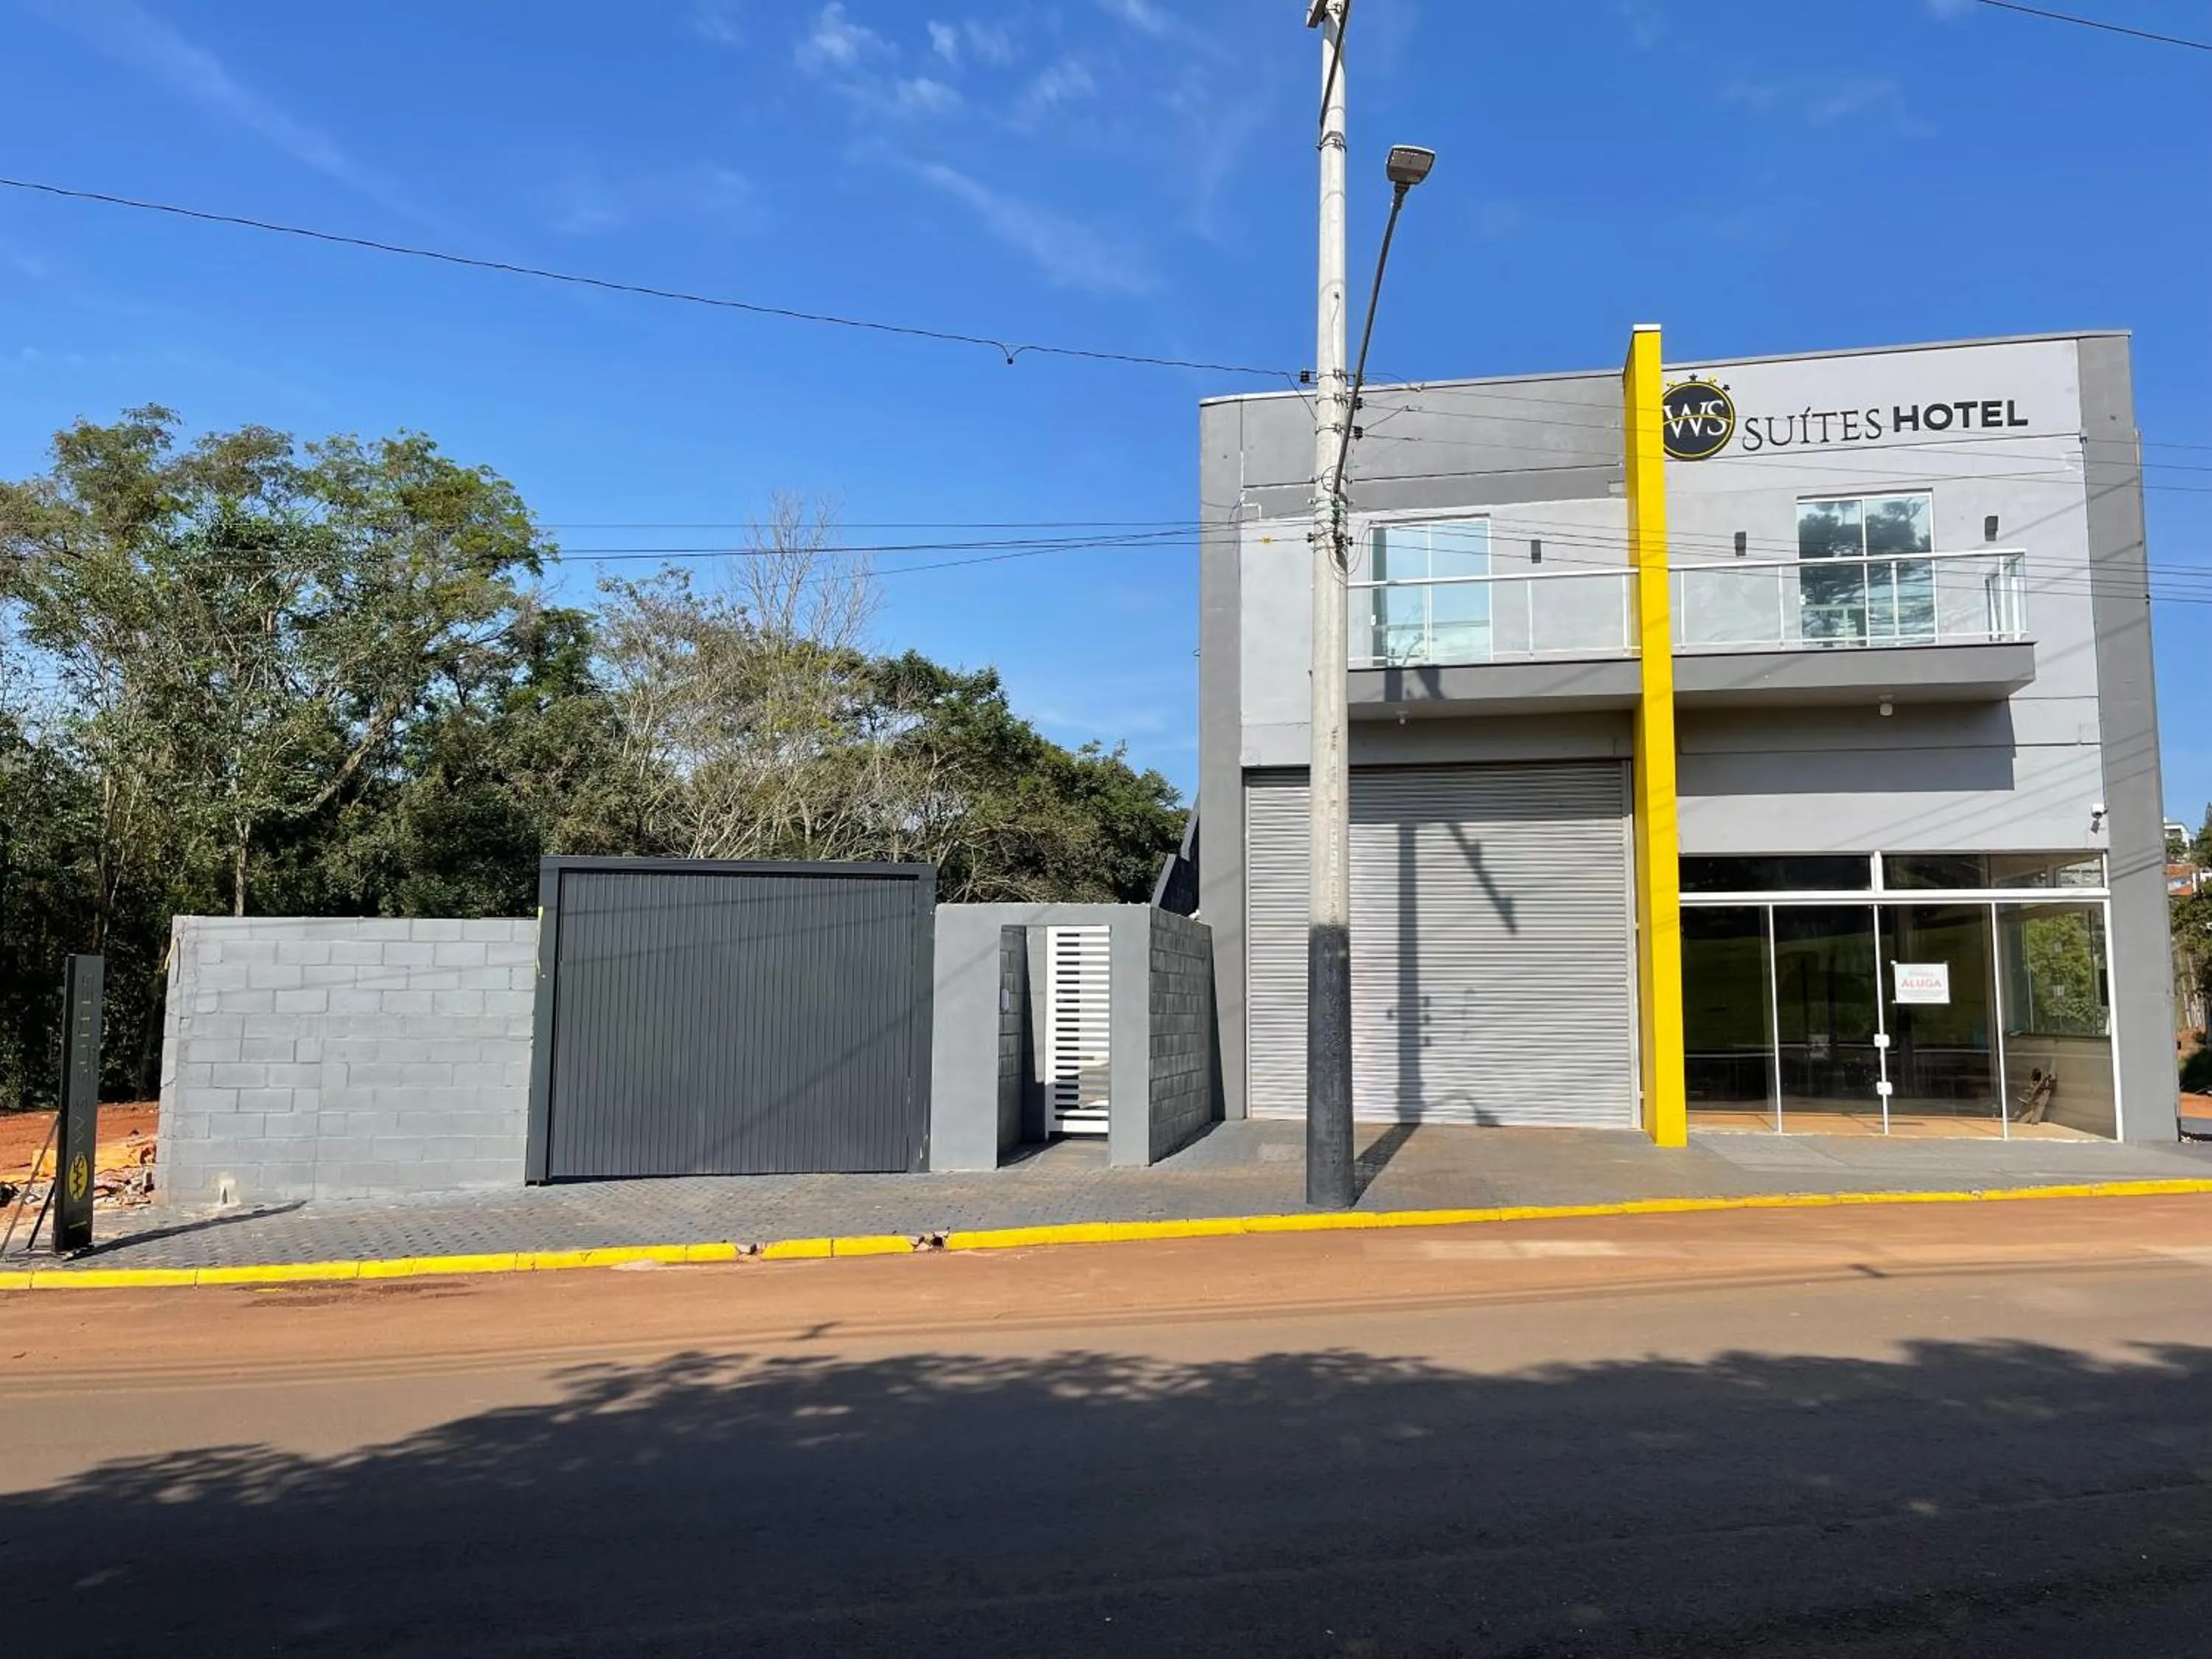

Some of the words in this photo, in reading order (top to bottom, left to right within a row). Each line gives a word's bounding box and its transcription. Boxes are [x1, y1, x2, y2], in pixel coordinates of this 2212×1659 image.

[1663, 400, 1726, 439] WS
[1742, 407, 1883, 451] SUÍTES
[1893, 399, 2028, 433] HOTEL
[1901, 978, 1942, 989] ALUGA
